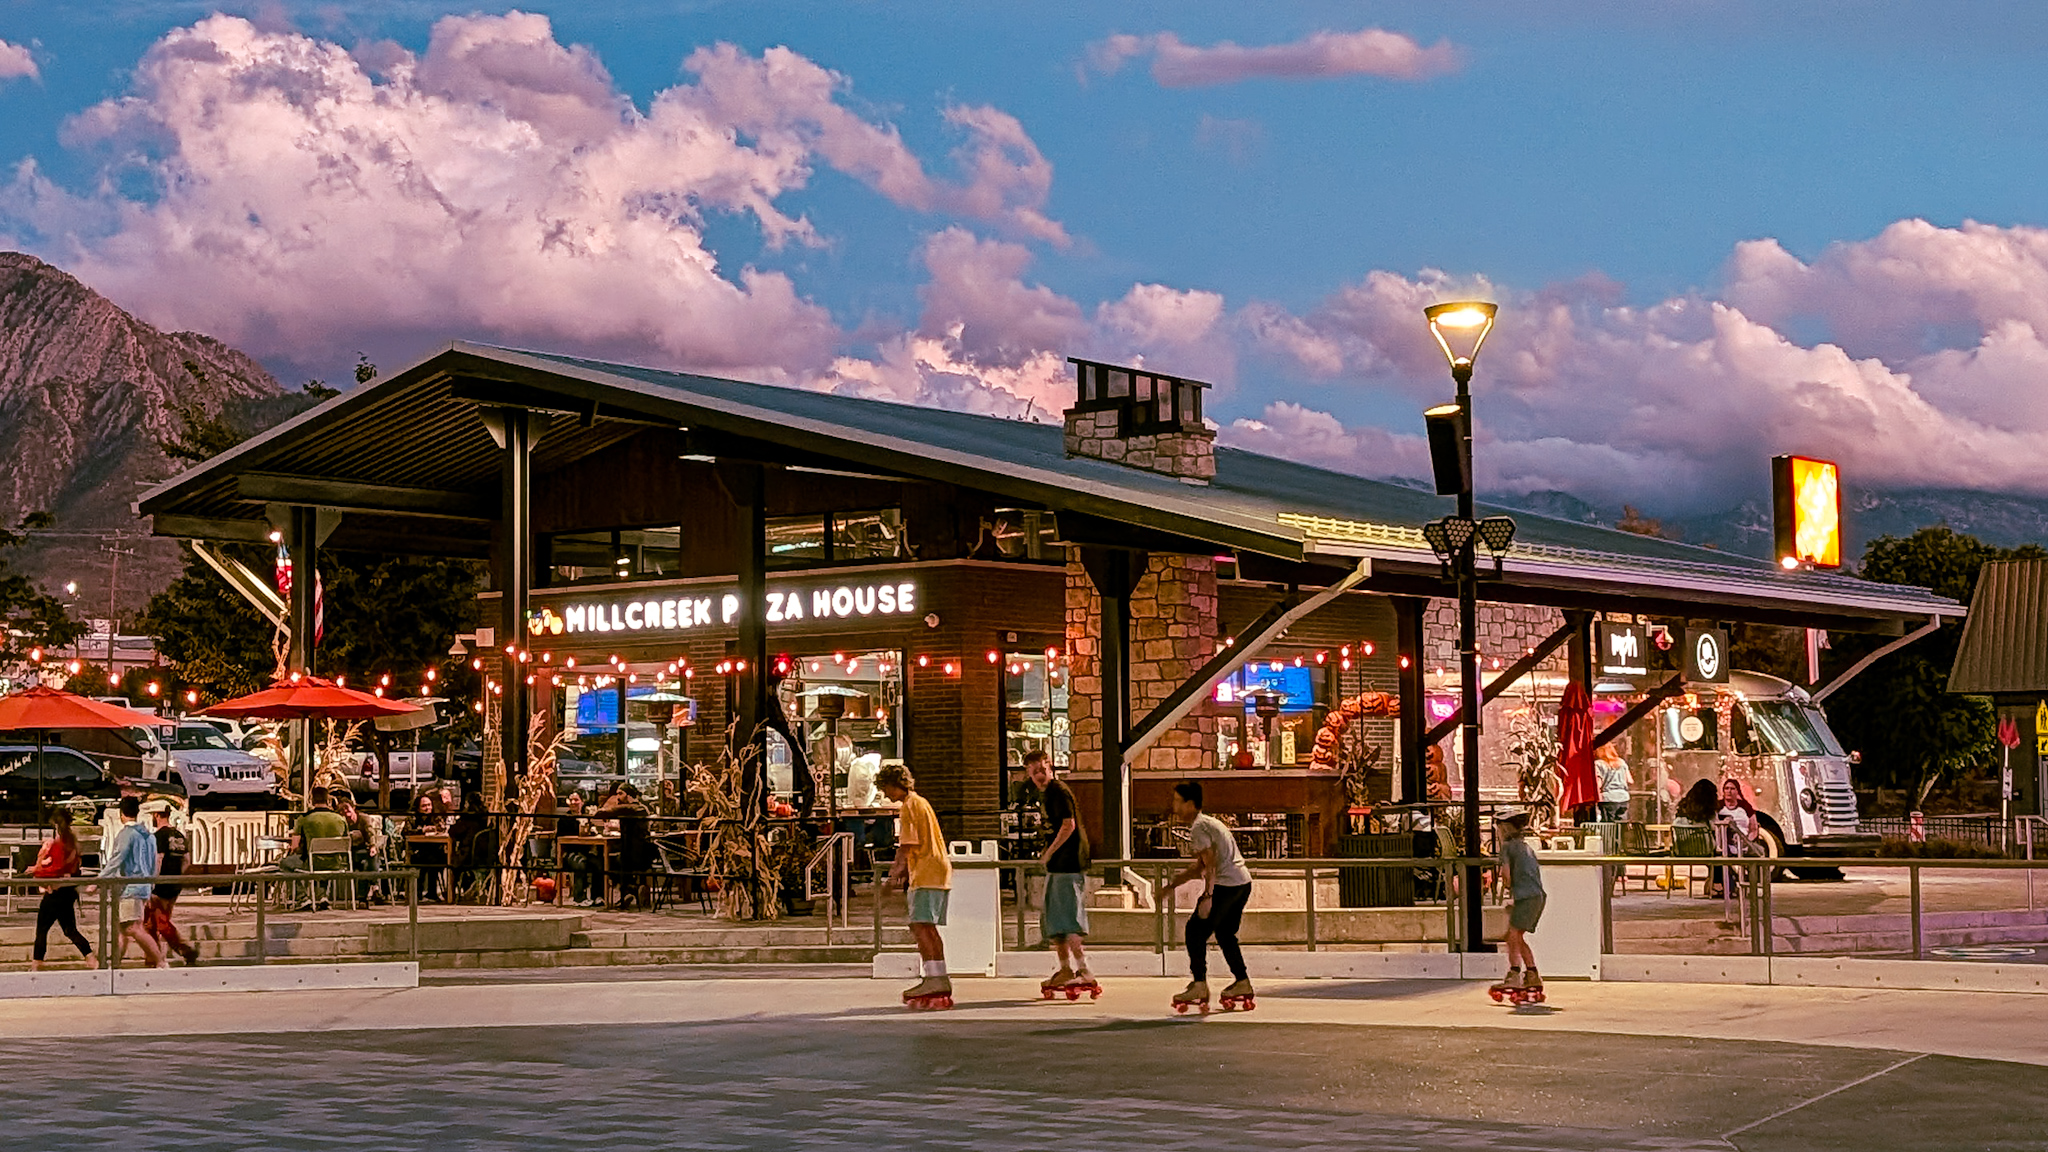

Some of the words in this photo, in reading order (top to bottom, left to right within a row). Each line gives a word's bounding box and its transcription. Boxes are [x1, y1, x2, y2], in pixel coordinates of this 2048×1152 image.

[565, 595, 712, 633] MILLCREEK
[721, 592, 804, 624] PZA
[812, 583, 915, 619] HOUSE
